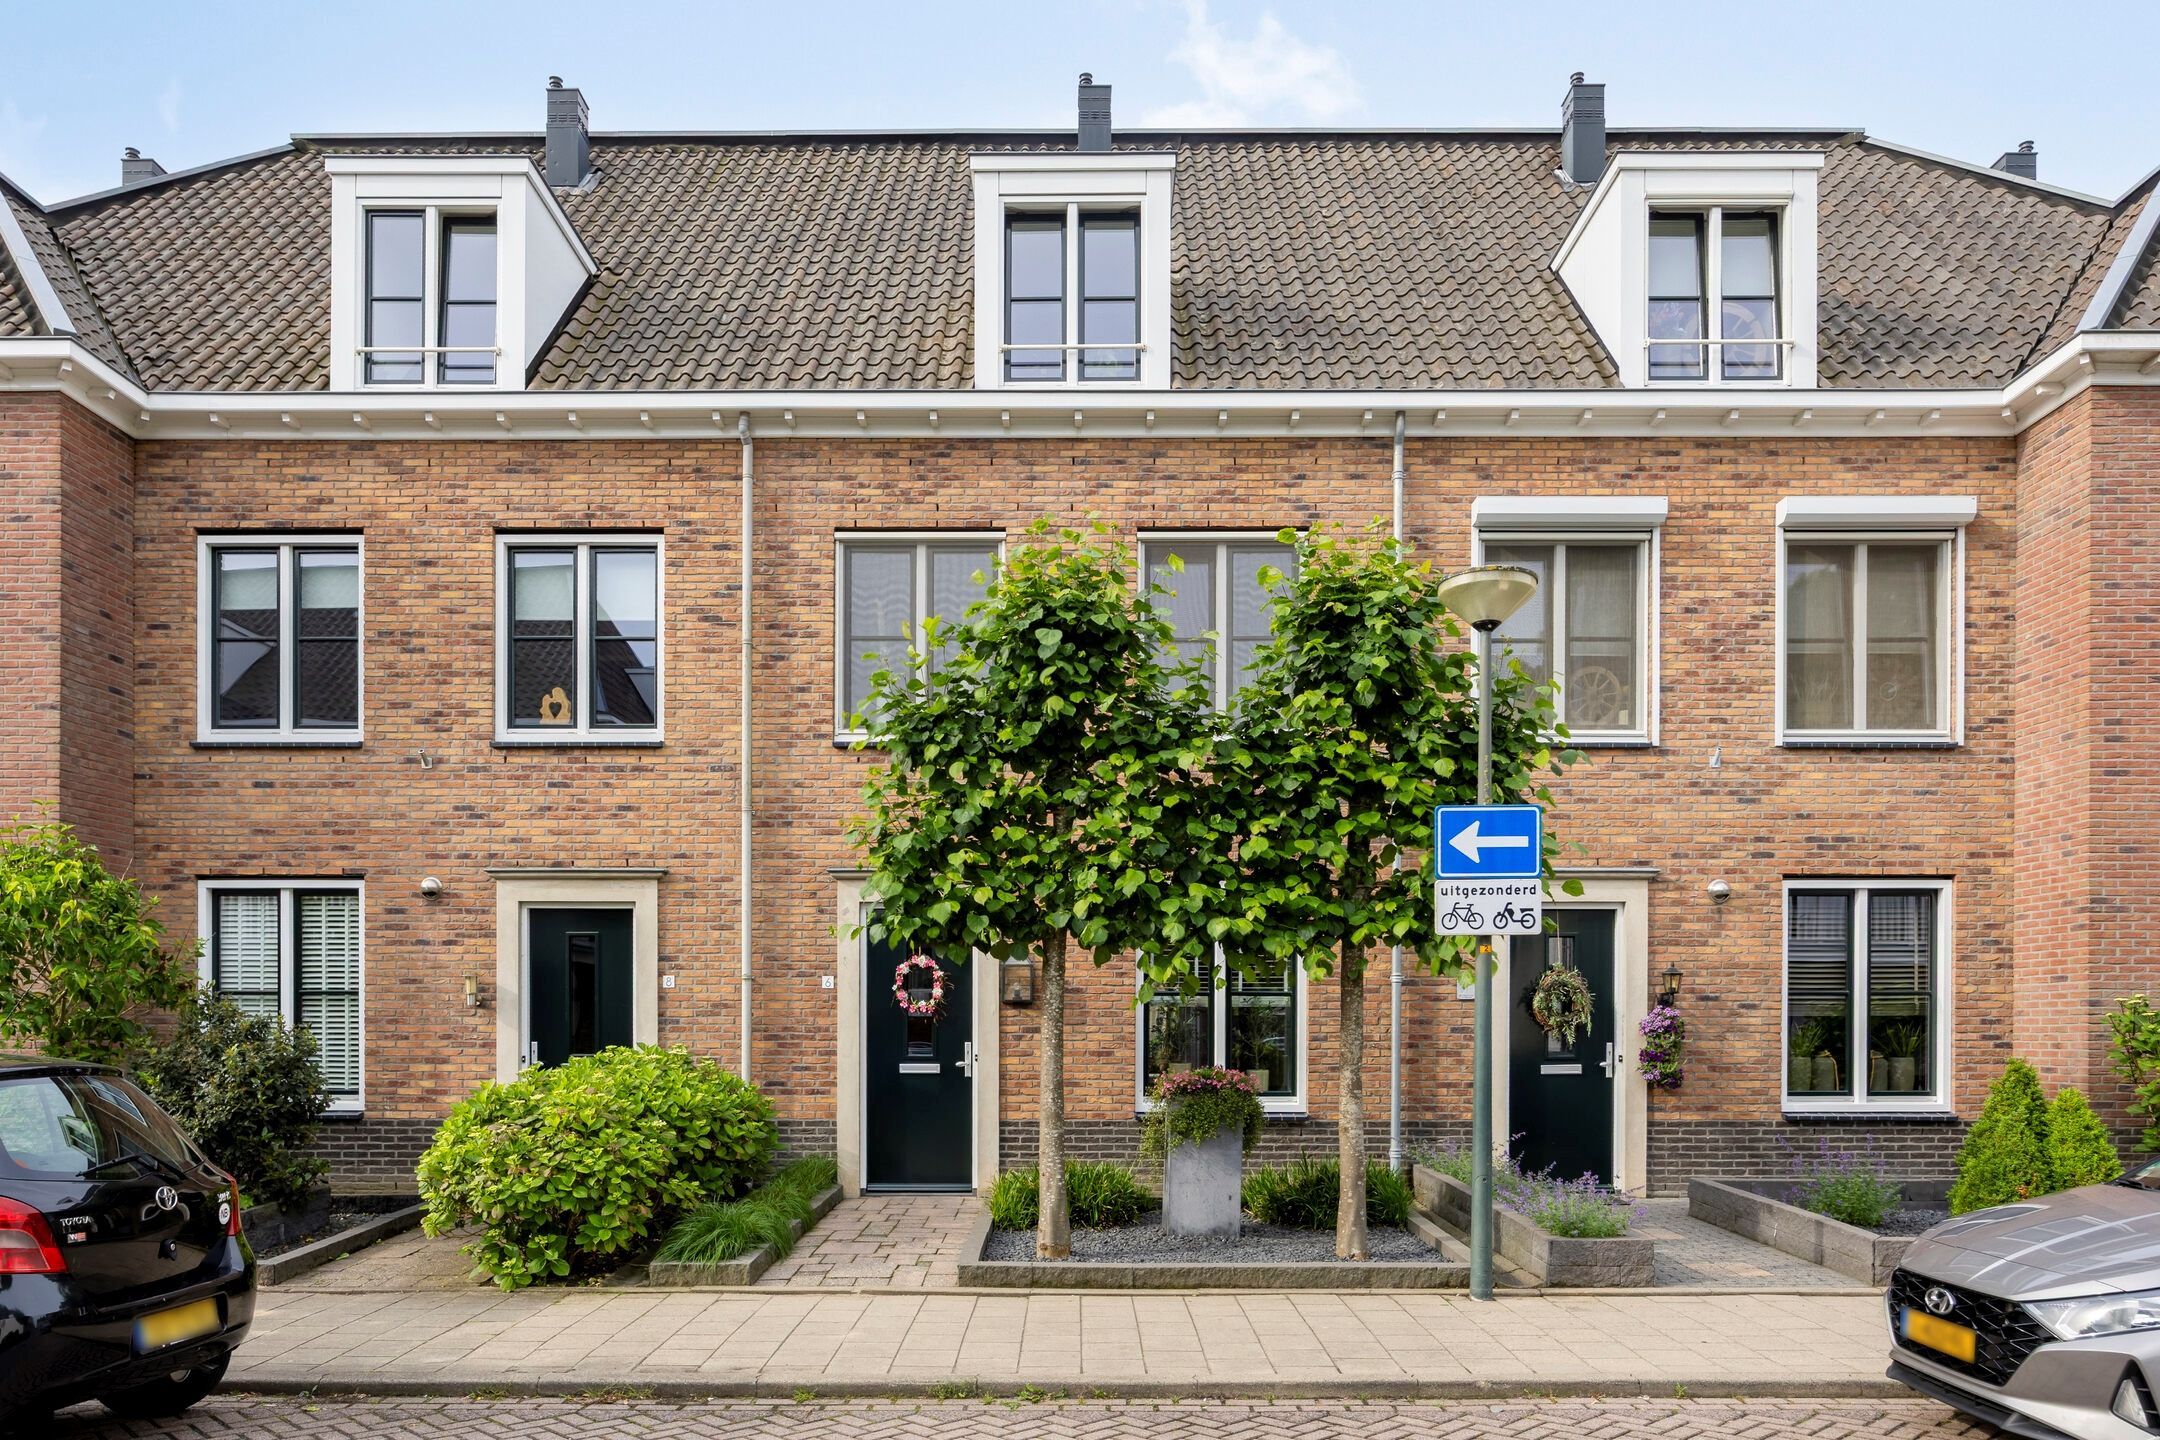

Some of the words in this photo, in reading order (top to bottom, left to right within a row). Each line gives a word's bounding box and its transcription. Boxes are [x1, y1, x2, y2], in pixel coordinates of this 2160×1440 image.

[1441, 884, 1537, 899] uitgezonderd
[665, 976, 673, 987] 8
[825, 977, 832, 988] 6
[60, 1216, 94, 1227] TOYOTA
